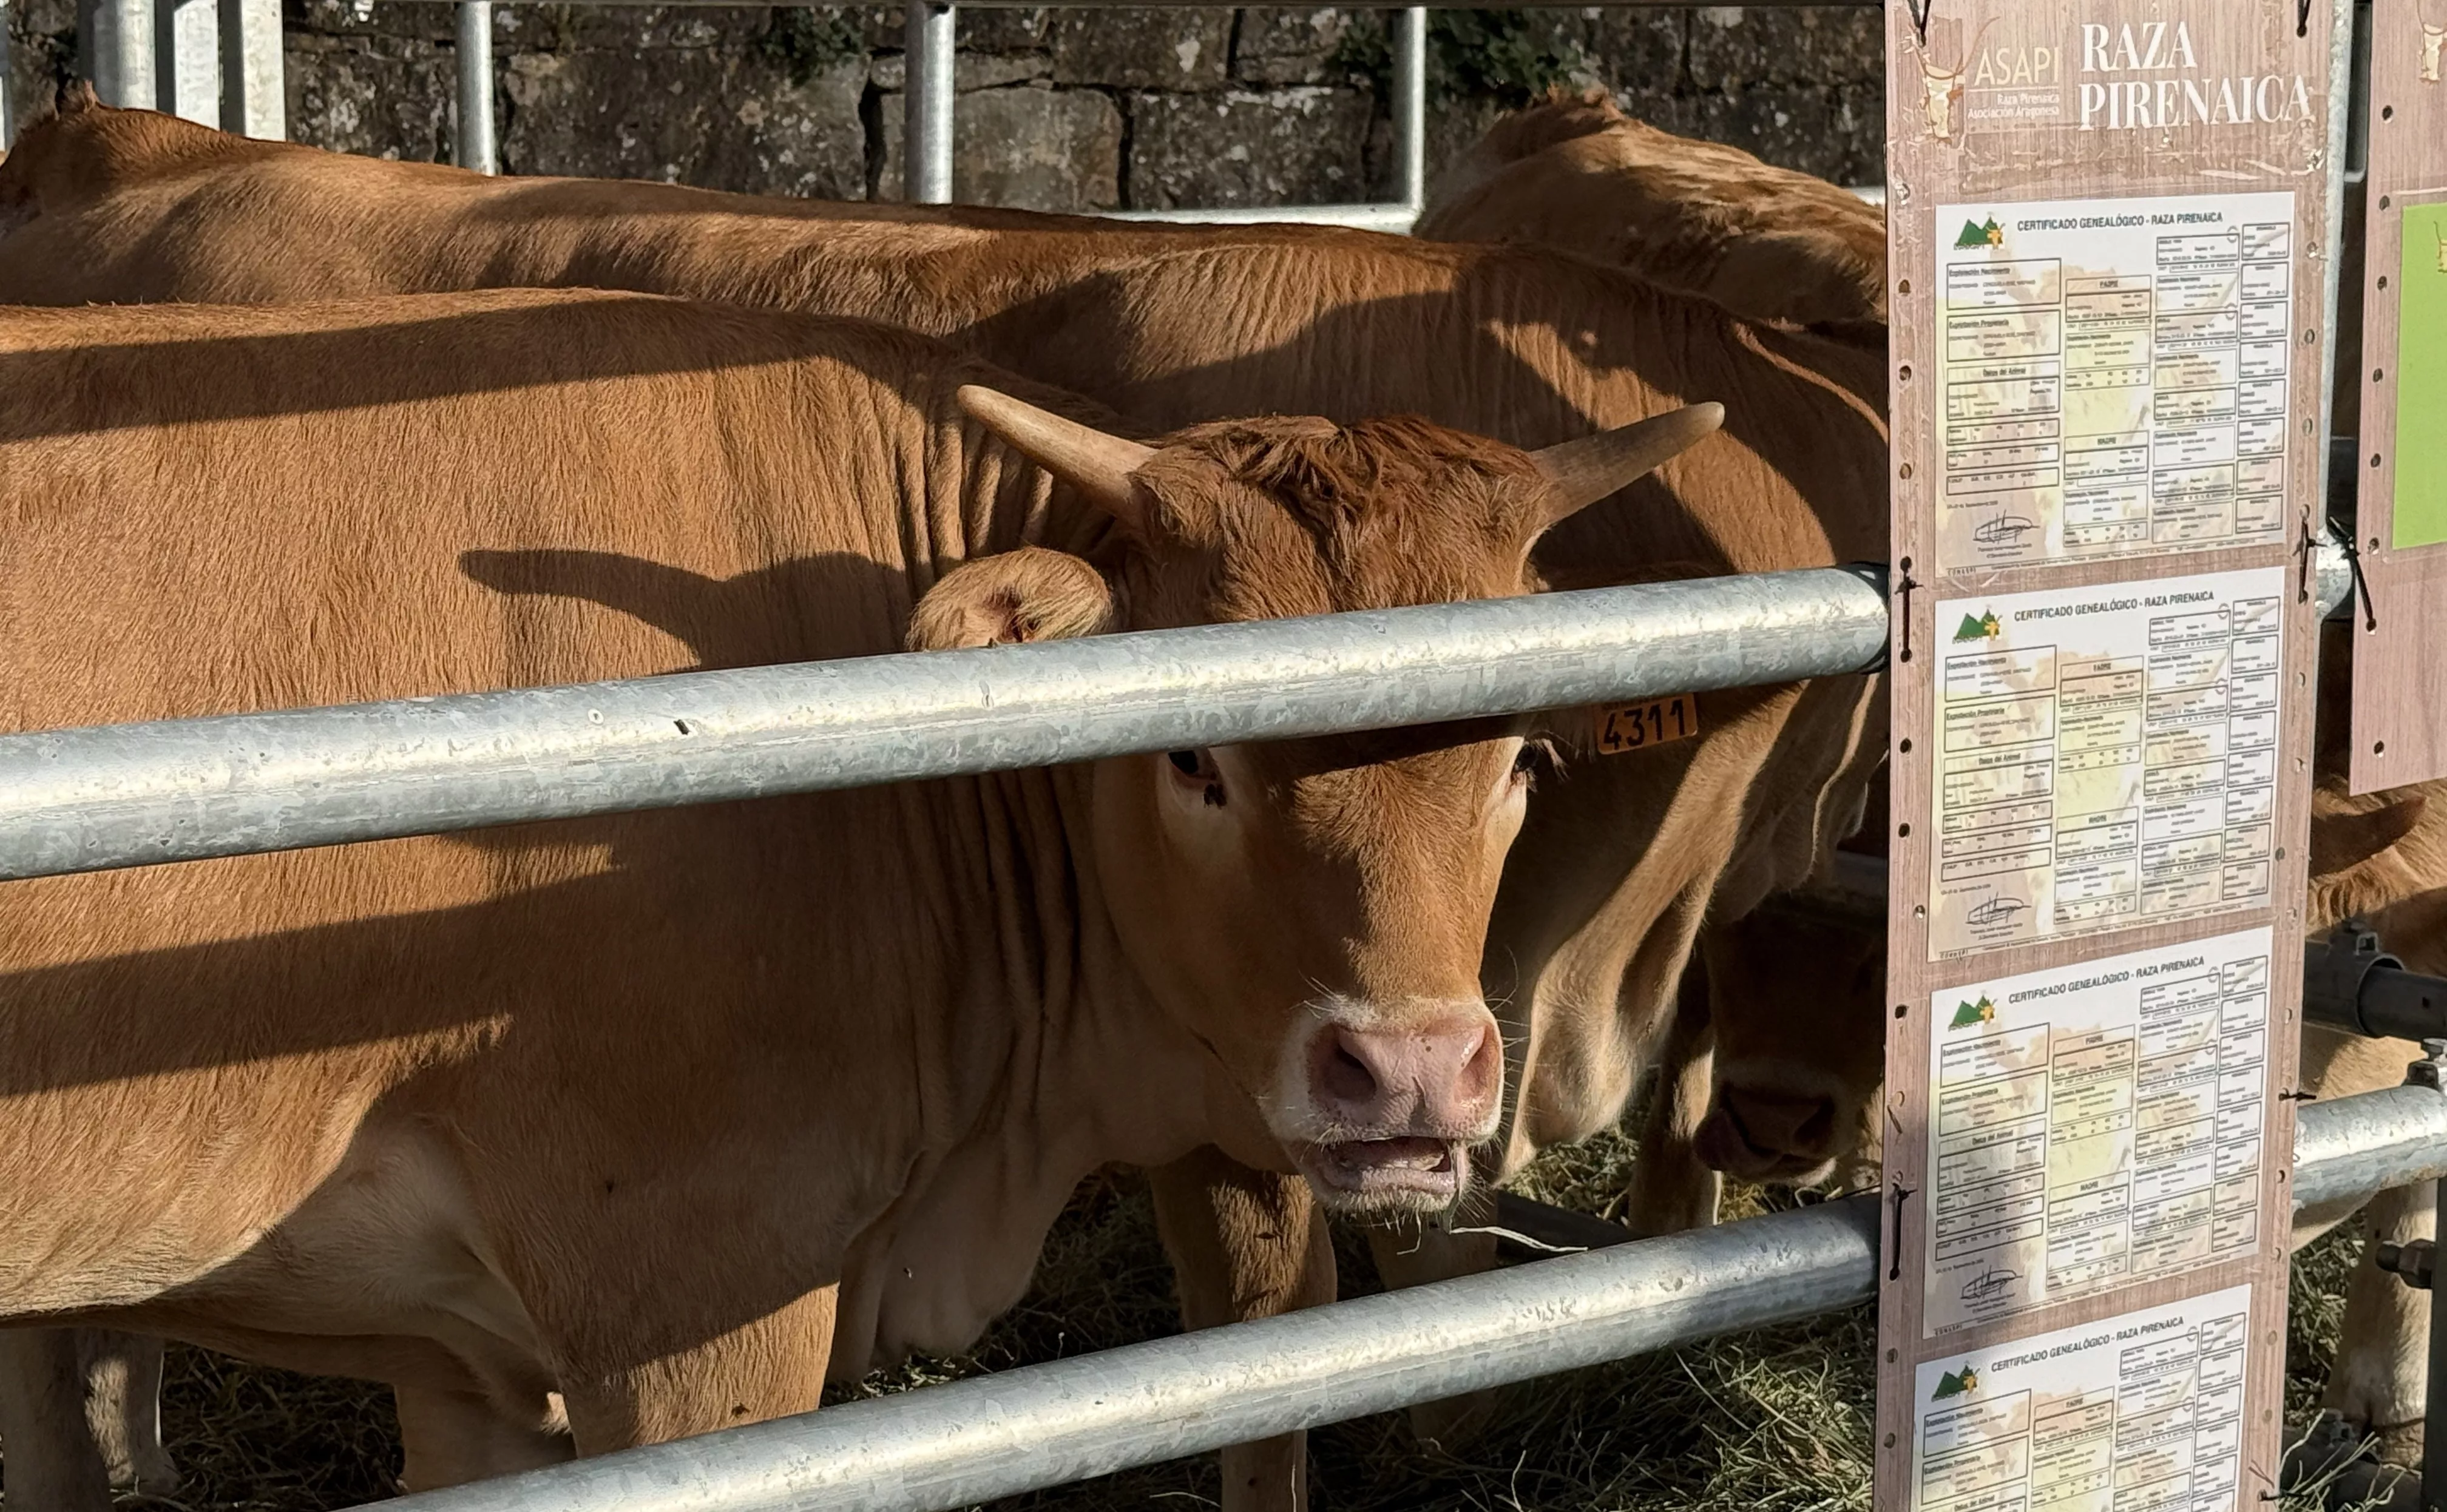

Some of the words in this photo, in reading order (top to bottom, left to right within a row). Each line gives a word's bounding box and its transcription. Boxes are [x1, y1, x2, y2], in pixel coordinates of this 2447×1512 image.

[1974, 47, 2060, 86] ASAPI
[2081, 21, 2198, 72] RAZA
[1997, 93, 2017, 106] Raza
[2078, 75, 2313, 132] PIRENAICA
[2017, 218, 2077, 231] CERTIFICADO
[2079, 214, 2144, 229] GENEALÓGICO
[2151, 214, 2175, 225] RAZA
[2176, 212, 2224, 224] PIRENAICA
[2014, 605, 2074, 621] CERTIFICADO
[2075, 598, 2138, 615] GENEALÓGICO
[2144, 595, 2168, 607] RAZA
[2169, 591, 2215, 605] PIRENAICA
[1603, 699, 1685, 750] 4311
[2008, 983, 2066, 1004] CERTIFICADO
[2068, 971, 2130, 993] GENEALÓGICO
[2136, 965, 2159, 979] RAZA
[2160, 956, 2205, 973] PIRENAICA
[1991, 1351, 2048, 1372] CERTIFICADO
[2049, 1334, 2110, 1358] GENEALÓGICO
[2116, 1329, 2139, 1342] RAZA
[2140, 1316, 2185, 1335] PIRENAICA
